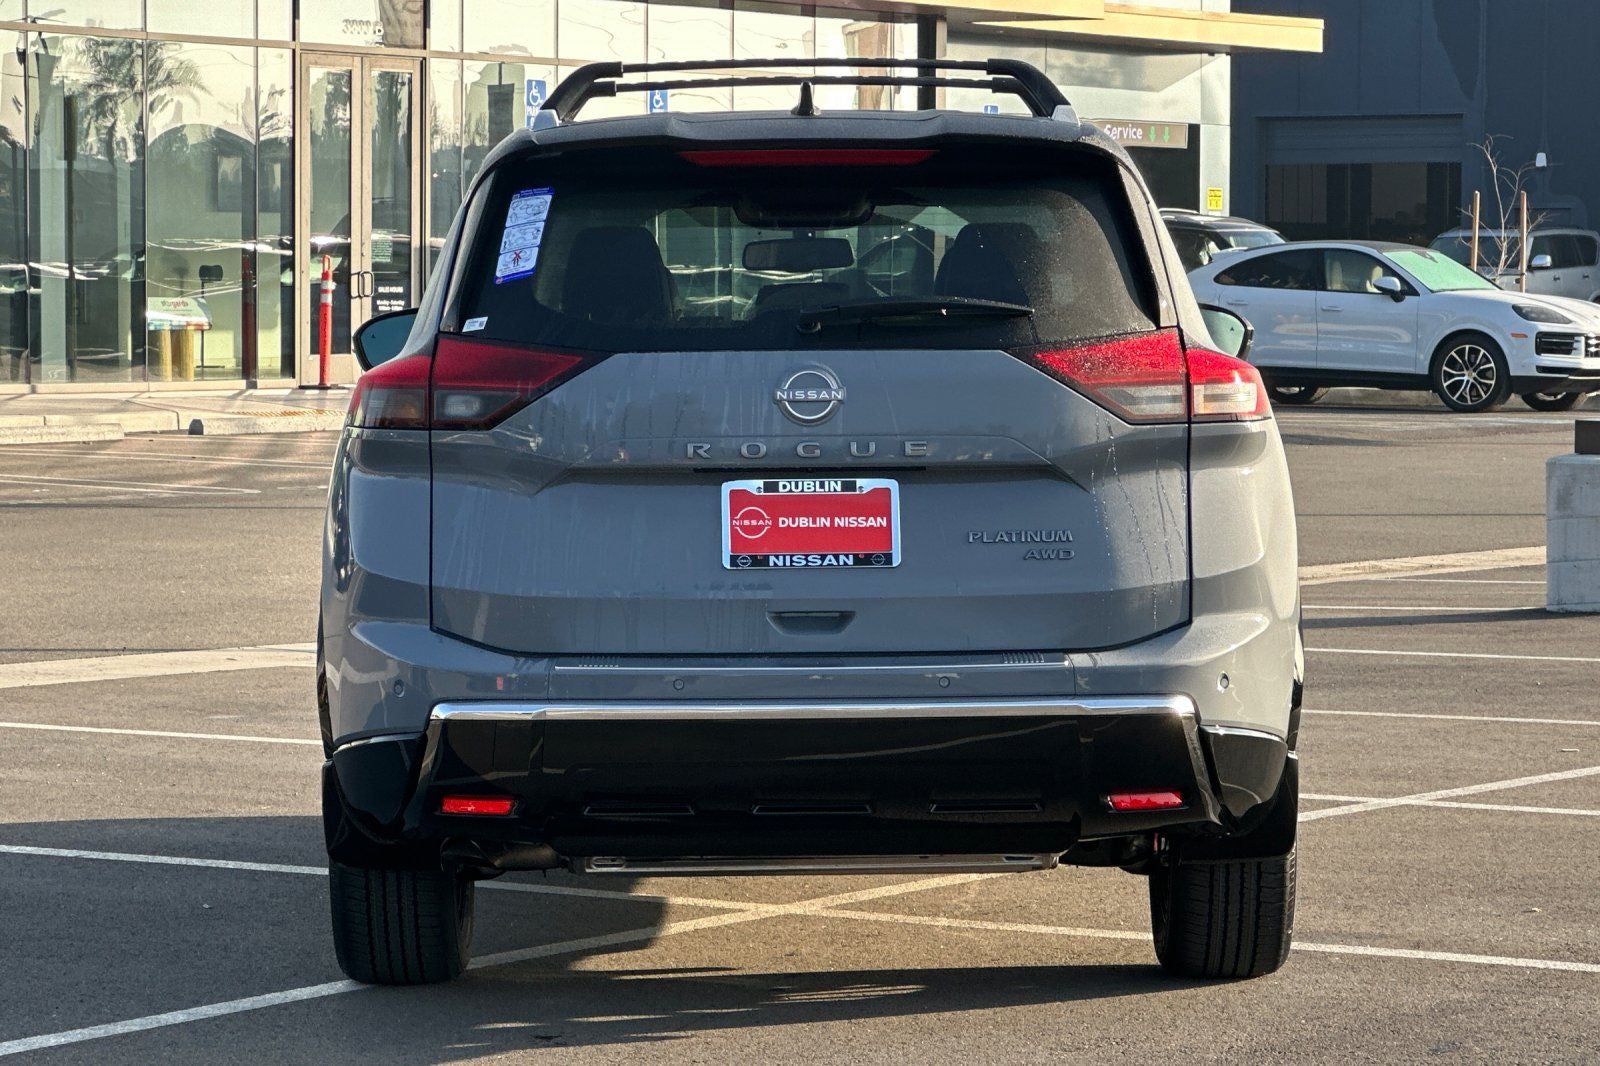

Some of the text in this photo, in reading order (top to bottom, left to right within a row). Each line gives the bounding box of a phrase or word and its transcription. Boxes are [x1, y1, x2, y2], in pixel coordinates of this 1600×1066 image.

[1104, 123, 1143, 140] Service
[776, 390, 843, 400] NISSAN
[687, 440, 928, 460] ROGUE
[778, 480, 842, 493] DUBLIN
[778, 516, 831, 528] DUBLIN
[834, 516, 888, 528] NISSAN
[967, 529, 1074, 543] PLATINUM
[768, 554, 854, 567] NISSAN
[1024, 548, 1076, 560] AWD
